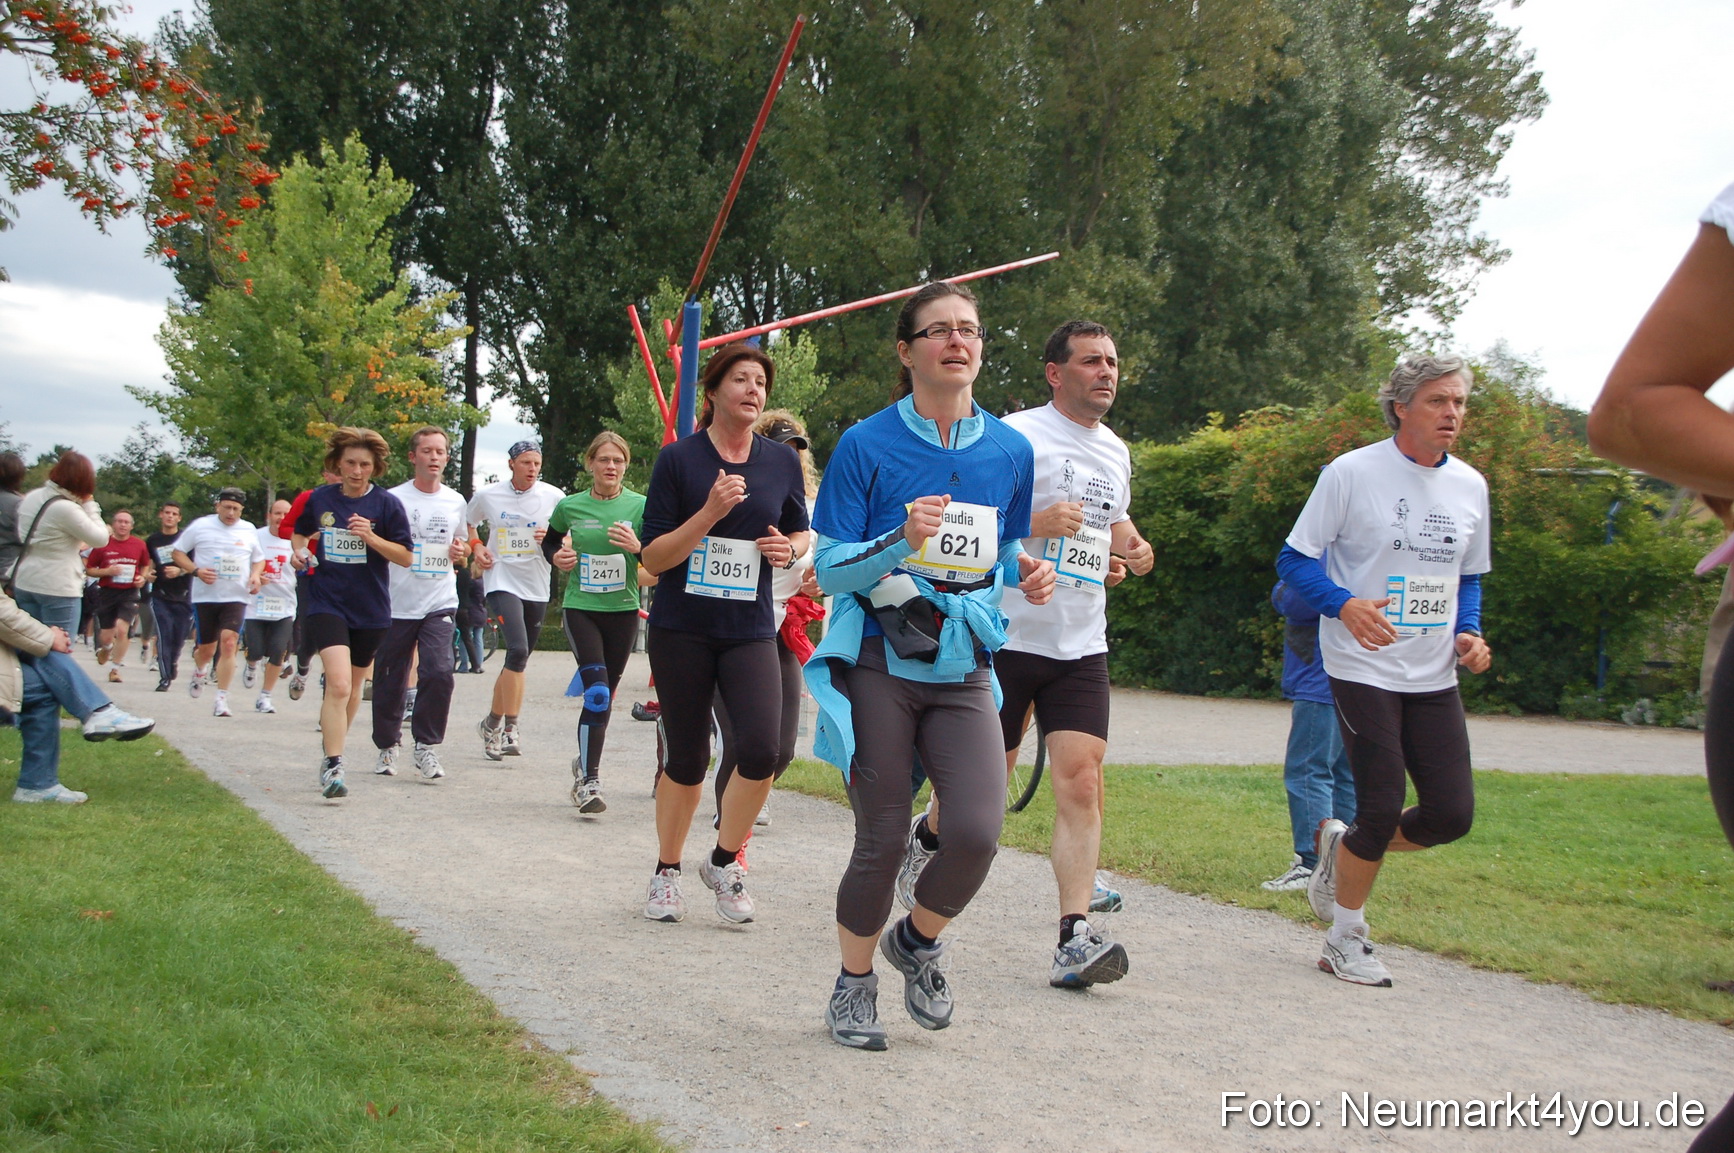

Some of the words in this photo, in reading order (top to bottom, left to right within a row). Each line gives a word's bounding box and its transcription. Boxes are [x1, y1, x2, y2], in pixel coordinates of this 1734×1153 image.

[942, 510, 973, 526] laudia
[1083, 518, 1107, 530] tadtlauf
[1422, 524, 1456, 534] 21.09.2008
[336, 539, 365, 550] 2069
[511, 540, 530, 549] 885
[711, 542, 733, 555] Silke
[940, 533, 979, 558] 621
[1393, 539, 1405, 551] 9.
[1408, 544, 1455, 556] Neumarkter
[425, 556, 448, 567] 3700
[592, 558, 608, 566] Petra
[694, 556, 699, 565] C
[1067, 548, 1101, 571] 2849
[1418, 553, 1454, 563] Stadtlauf
[593, 569, 620, 579] 2471
[710, 560, 751, 579] 3051
[1409, 581, 1444, 593] Gerhard
[1409, 599, 1447, 615] 2848
